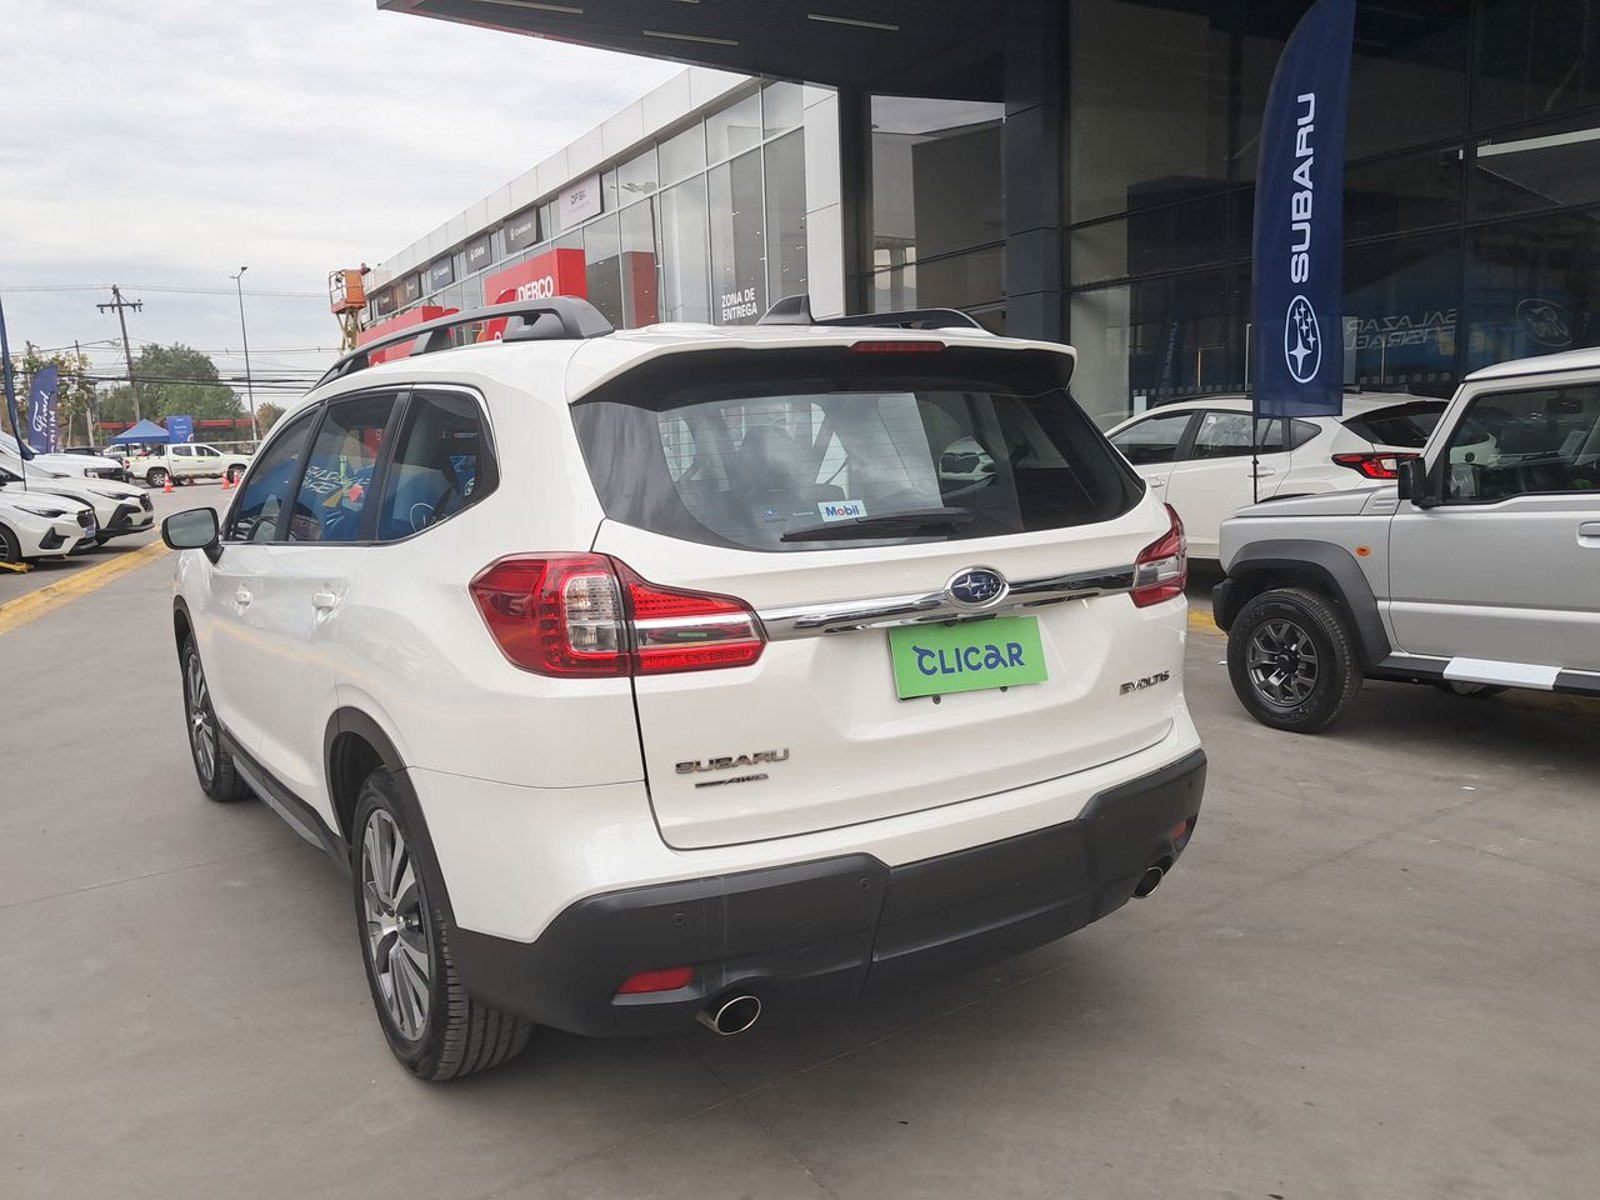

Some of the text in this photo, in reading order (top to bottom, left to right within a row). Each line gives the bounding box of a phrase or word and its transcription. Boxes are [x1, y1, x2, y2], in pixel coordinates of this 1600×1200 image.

[1291, 92, 1316, 284] SUBARU
[517, 275, 554, 301] DERCO
[721, 288, 756, 308] ZONA DE
[722, 302, 758, 320] ENTREGA
[825, 505, 860, 517] Mobil
[1120, 670, 1170, 696] EVOLTIS
[675, 748, 789, 774] SUBARU
